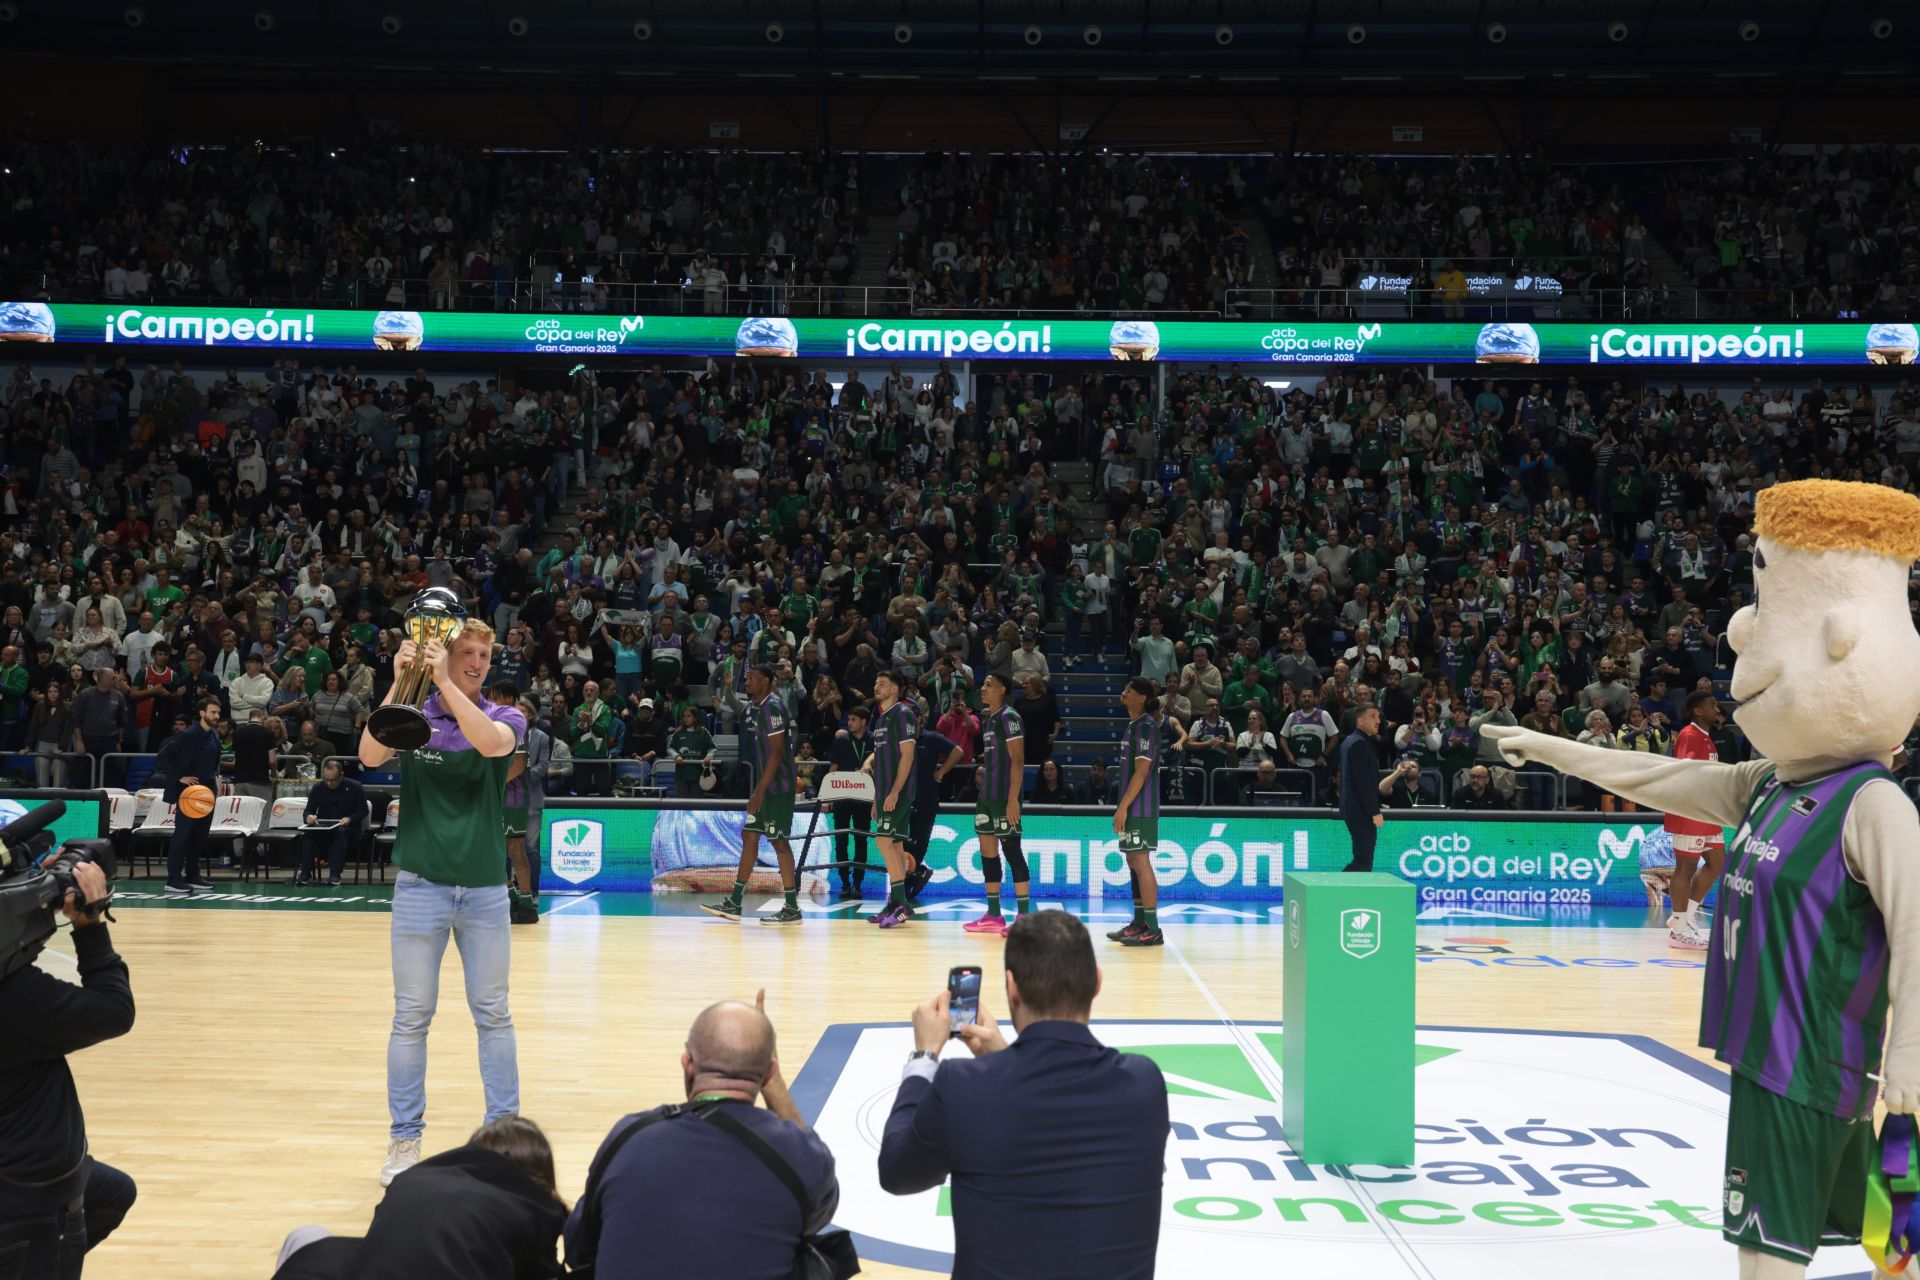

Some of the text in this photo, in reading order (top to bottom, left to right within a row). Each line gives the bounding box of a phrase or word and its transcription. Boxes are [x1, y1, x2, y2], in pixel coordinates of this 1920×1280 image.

[105, 310, 314, 345] ¡Campeón!
[535, 319, 561, 329] acb
[1271, 328, 1297, 337] acb
[525, 327, 628, 344] Copa del Rey
[846, 321, 1051, 357] ¡Campeón!
[1261, 335, 1365, 353] Copa del Rey
[1590, 325, 1804, 363] ¡Campeón!
[535, 344, 617, 353] Gran Canaria 2025
[1271, 353, 1355, 361] Gran Canaria 2025
[831, 780, 866, 789] Wilson
[1419, 832, 1471, 852] acb
[1399, 849, 1614, 886] Copa del Rey
[1421, 886, 1591, 903] Gran Canaria 2025
